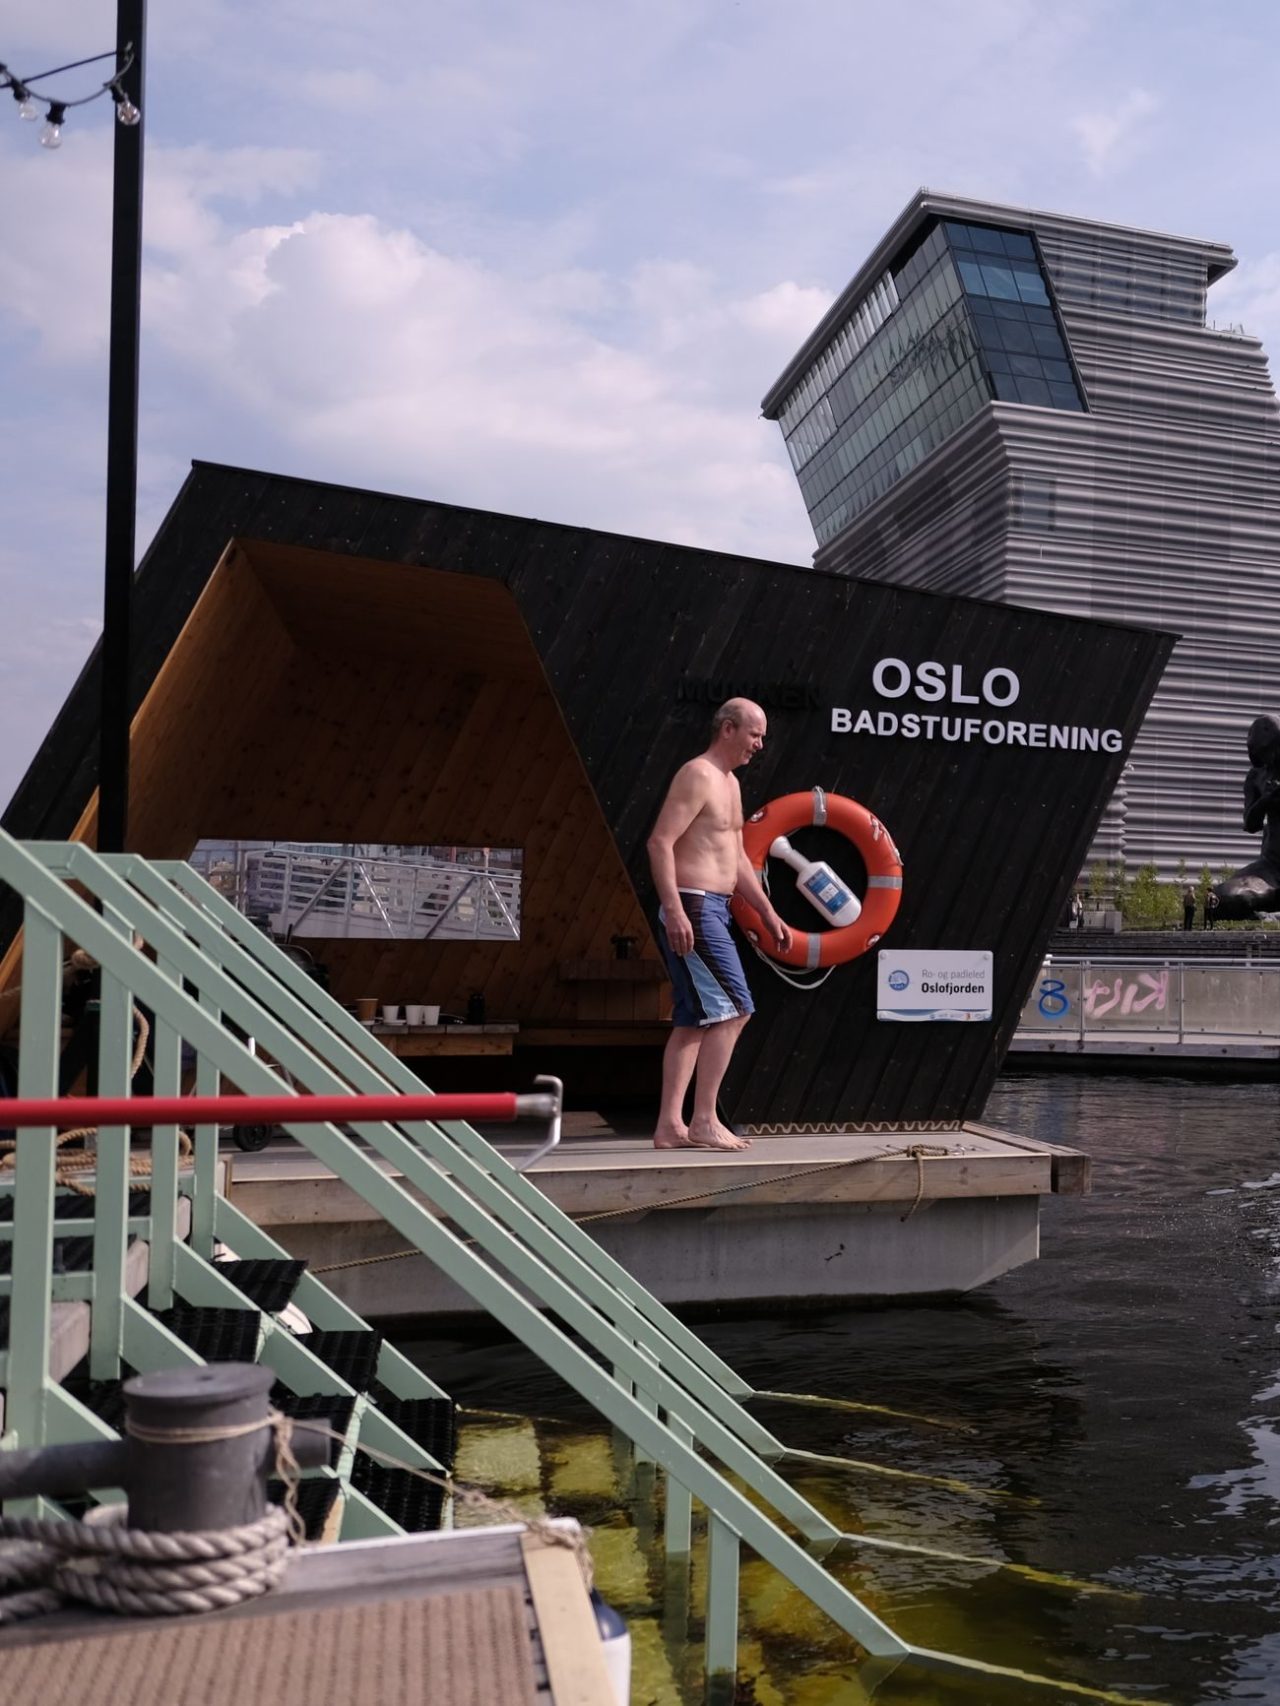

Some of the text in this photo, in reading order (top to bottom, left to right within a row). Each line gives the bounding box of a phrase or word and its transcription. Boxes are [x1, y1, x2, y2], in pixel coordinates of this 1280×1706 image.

[872, 656, 1021, 708] OSLO
[831, 707, 1123, 754] BADSTUFORENING
[921, 982, 985, 996] Oslofjorden
